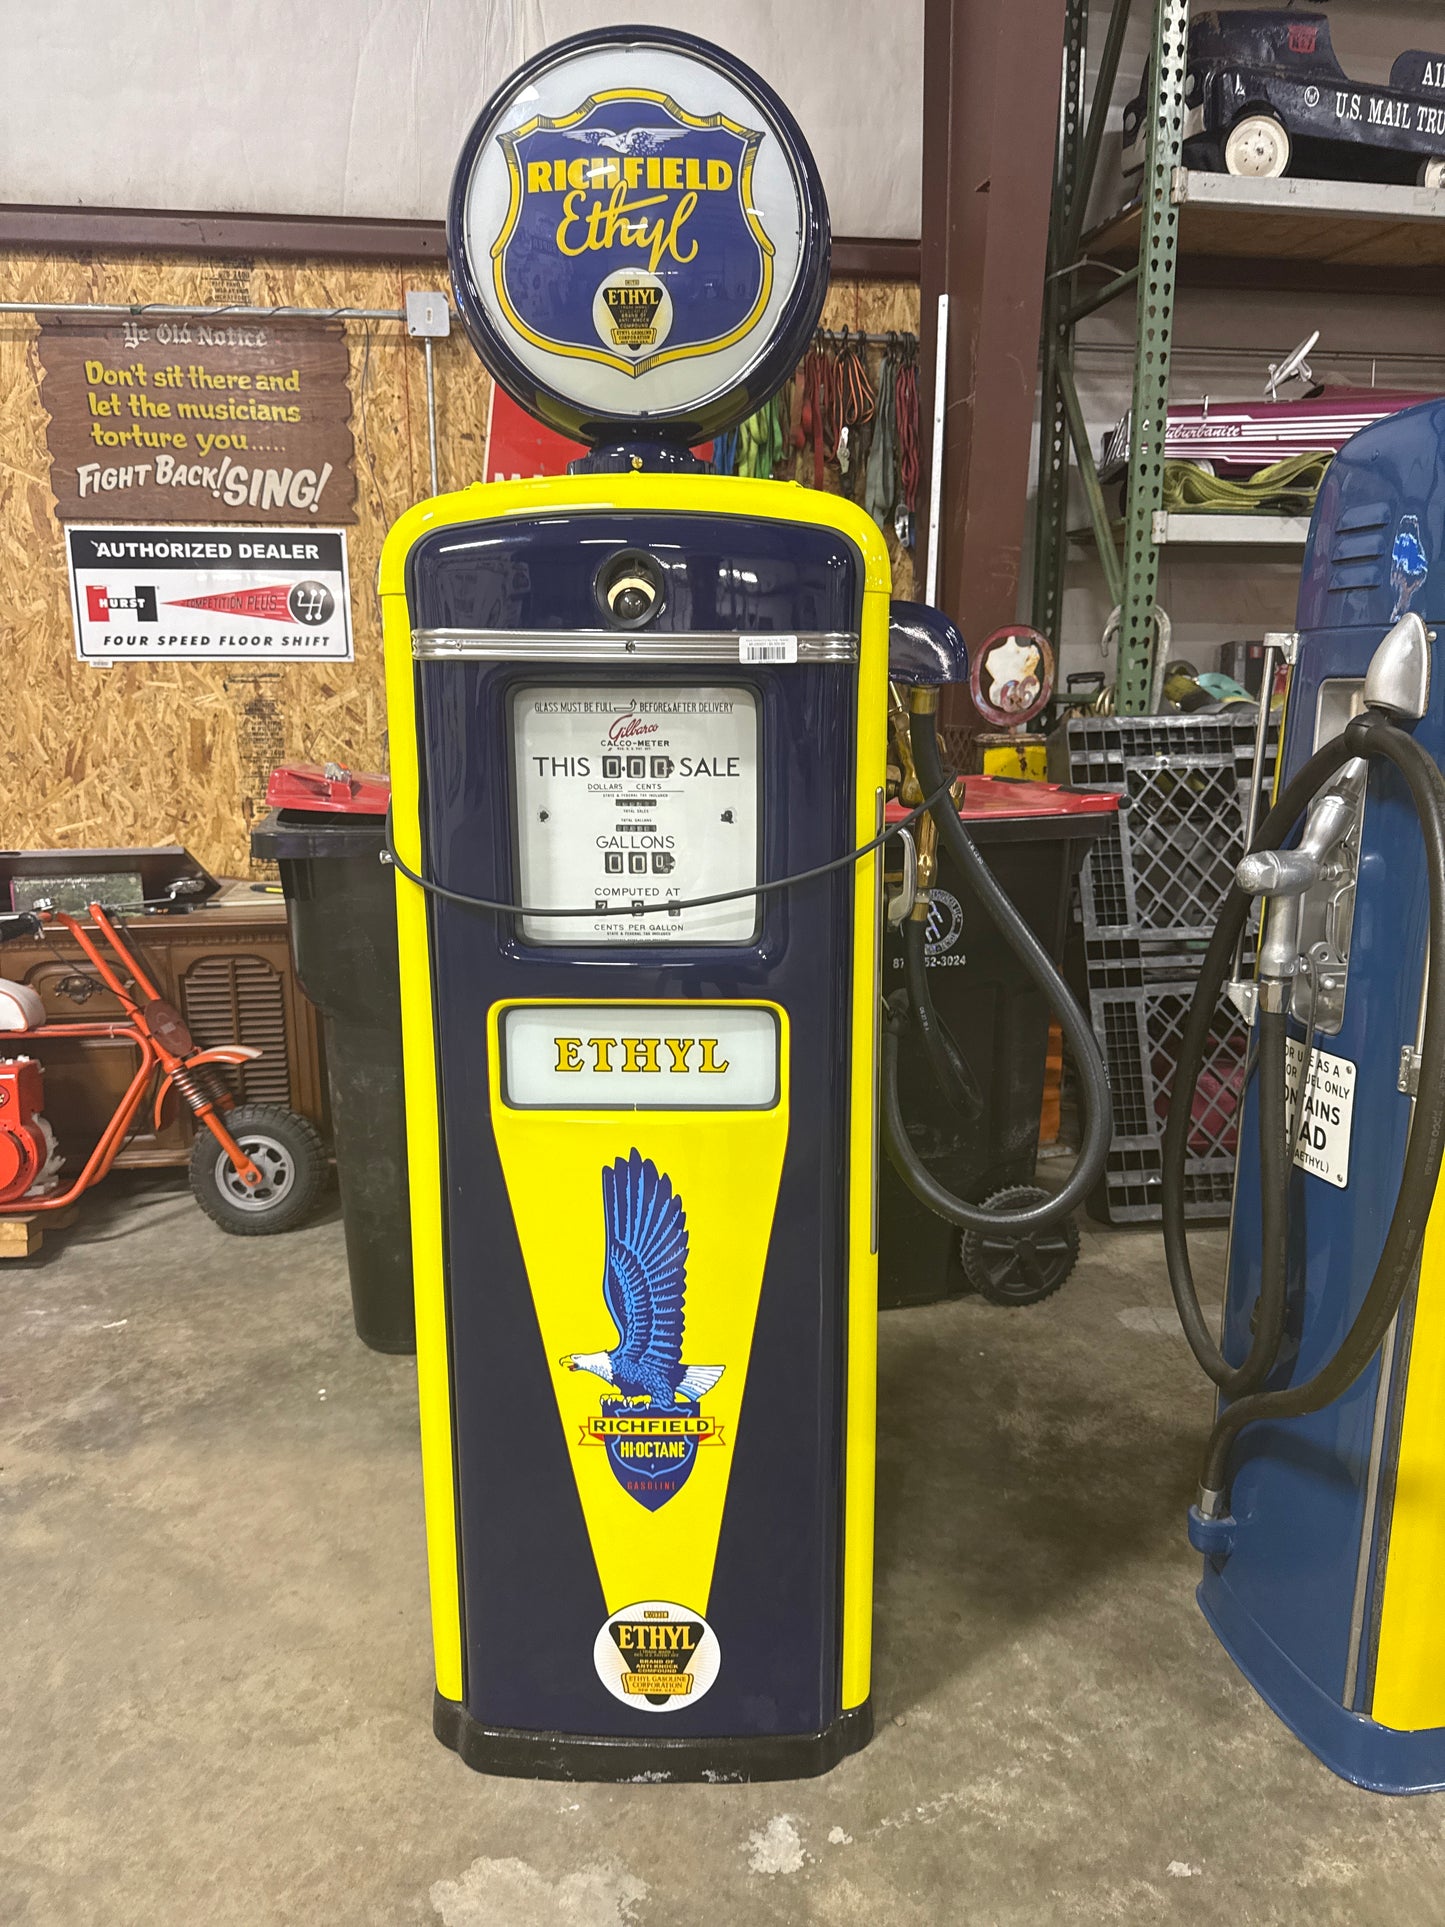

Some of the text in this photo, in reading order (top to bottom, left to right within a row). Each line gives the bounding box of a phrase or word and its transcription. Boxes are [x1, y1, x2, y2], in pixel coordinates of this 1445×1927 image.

[1335, 91, 1362, 120] U.S.
[1367, 98, 1411, 129] MAIL
[527, 157, 733, 193] RICHFIELD
[556, 179, 699, 271] Ethyl
[607, 289, 659, 305] ETHYL
[122, 321, 268, 349] Ye Old Notice
[84, 360, 301, 392] Don't sit there and
[87, 392, 301, 423] let the musicians
[90, 422, 187, 448] torture
[1165, 423, 1240, 439] uburbanite
[76, 463, 152, 498] FIGHT
[223, 462, 333, 513] SING!
[97, 542, 320, 559] AUTHORIZED DEALER
[98, 598, 146, 608] HURST
[246, 595, 278, 611] PLUS
[103, 636, 330, 646] FOUR SPEED FLOOR SHIFT
[534, 702, 559, 712] GLASS
[560, 702, 582, 712] MUST
[584, 702, 593, 712] BE
[595, 702, 612, 712] FULL
[699, 702, 734, 712] DELIVERY
[608, 713, 659, 742] Gilbarco
[532, 757, 591, 777] THIS
[679, 757, 740, 777] SALE
[596, 836, 675, 848] GALLONS
[594, 888, 680, 896] COMPUTED AT
[553, 1038, 730, 1073] ETHYL
[1317, 1058, 1330, 1073] AS
[1333, 1065, 1340, 1078] A
[1325, 1081, 1350, 1099] ONLY
[593, 1420, 709, 1433] RICHFIELD
[627, 1481, 676, 1490] GASOLINE
[618, 1625, 695, 1650] ETHYL
